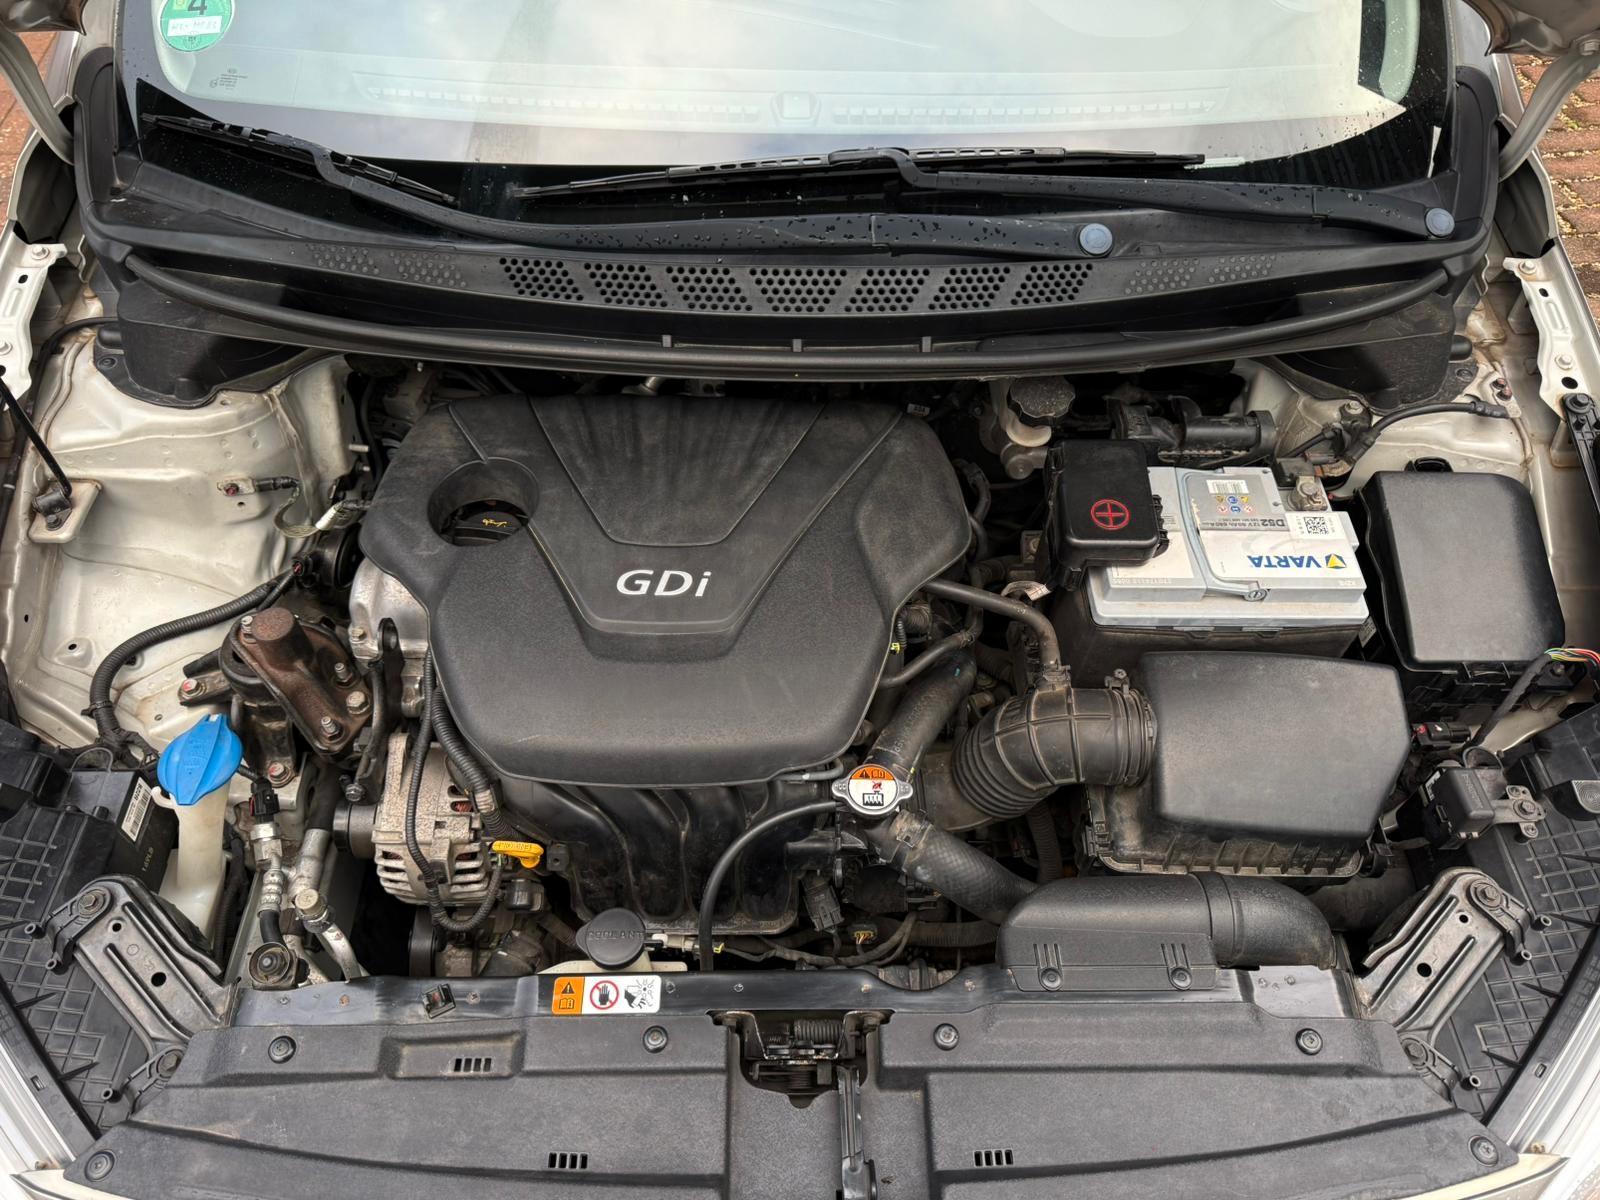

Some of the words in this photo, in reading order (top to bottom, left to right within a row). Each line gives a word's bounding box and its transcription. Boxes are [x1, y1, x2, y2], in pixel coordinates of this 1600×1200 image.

[1260, 518, 1285, 527] D52
[1247, 555, 1322, 569] VARTA
[616, 569, 712, 597] GDi
[586, 930, 644, 941] COOLANT
